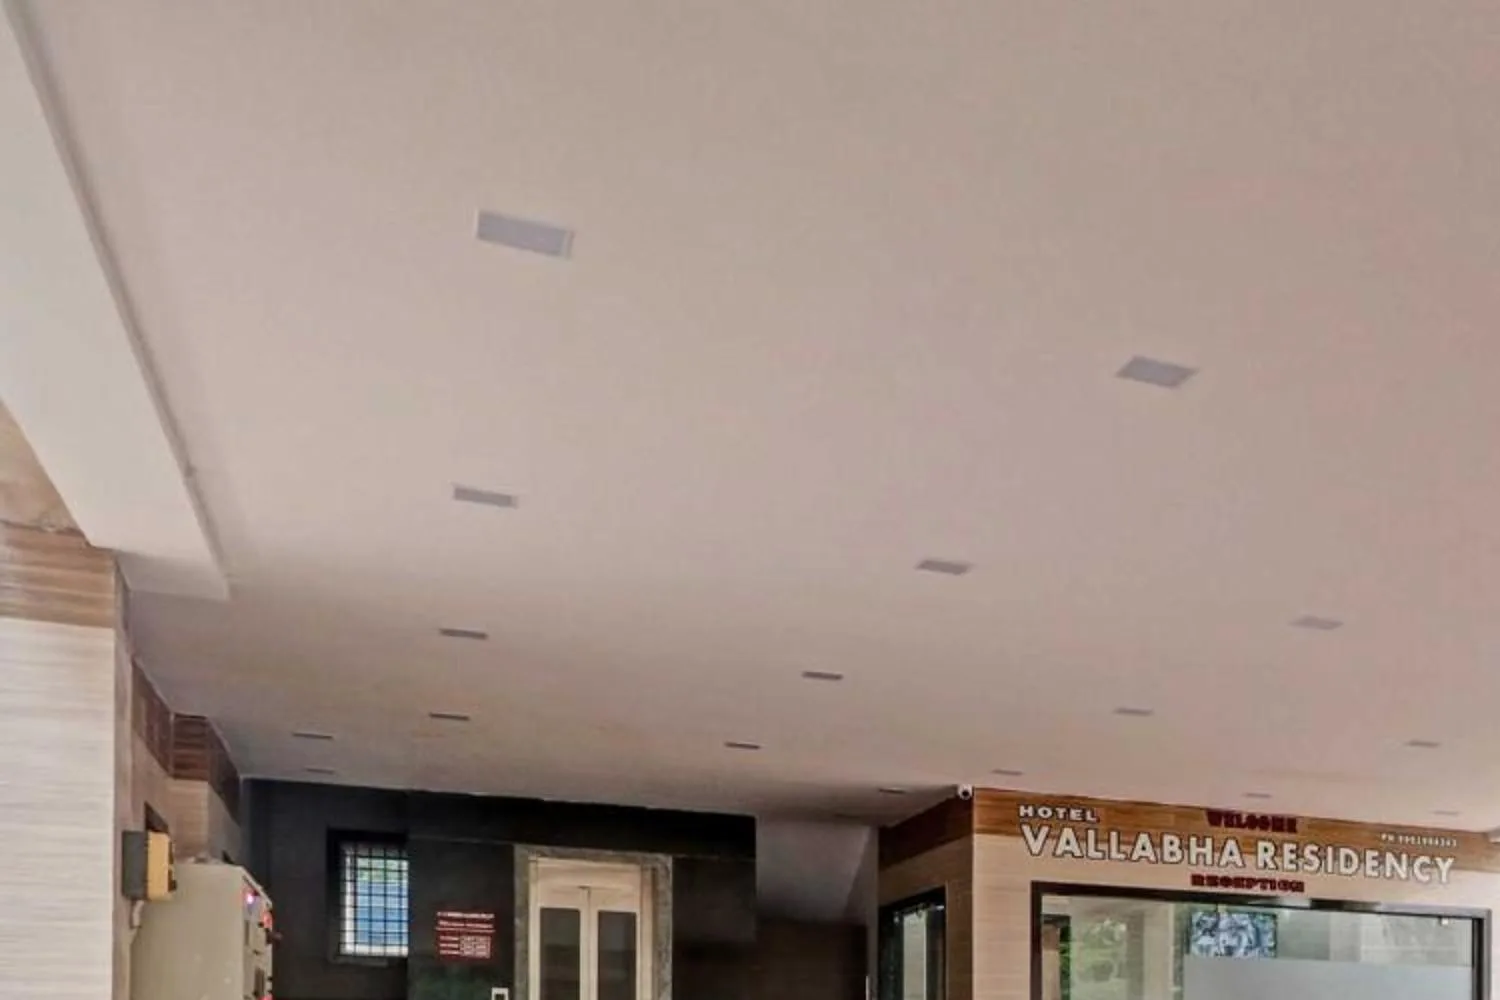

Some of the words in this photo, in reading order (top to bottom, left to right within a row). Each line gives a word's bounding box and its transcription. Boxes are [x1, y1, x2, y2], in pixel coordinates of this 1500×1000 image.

[1018, 805, 1098, 822] HOTEL
[1020, 823, 1246, 869] VALLABHA
[1256, 840, 1456, 884] RESIDENCY
